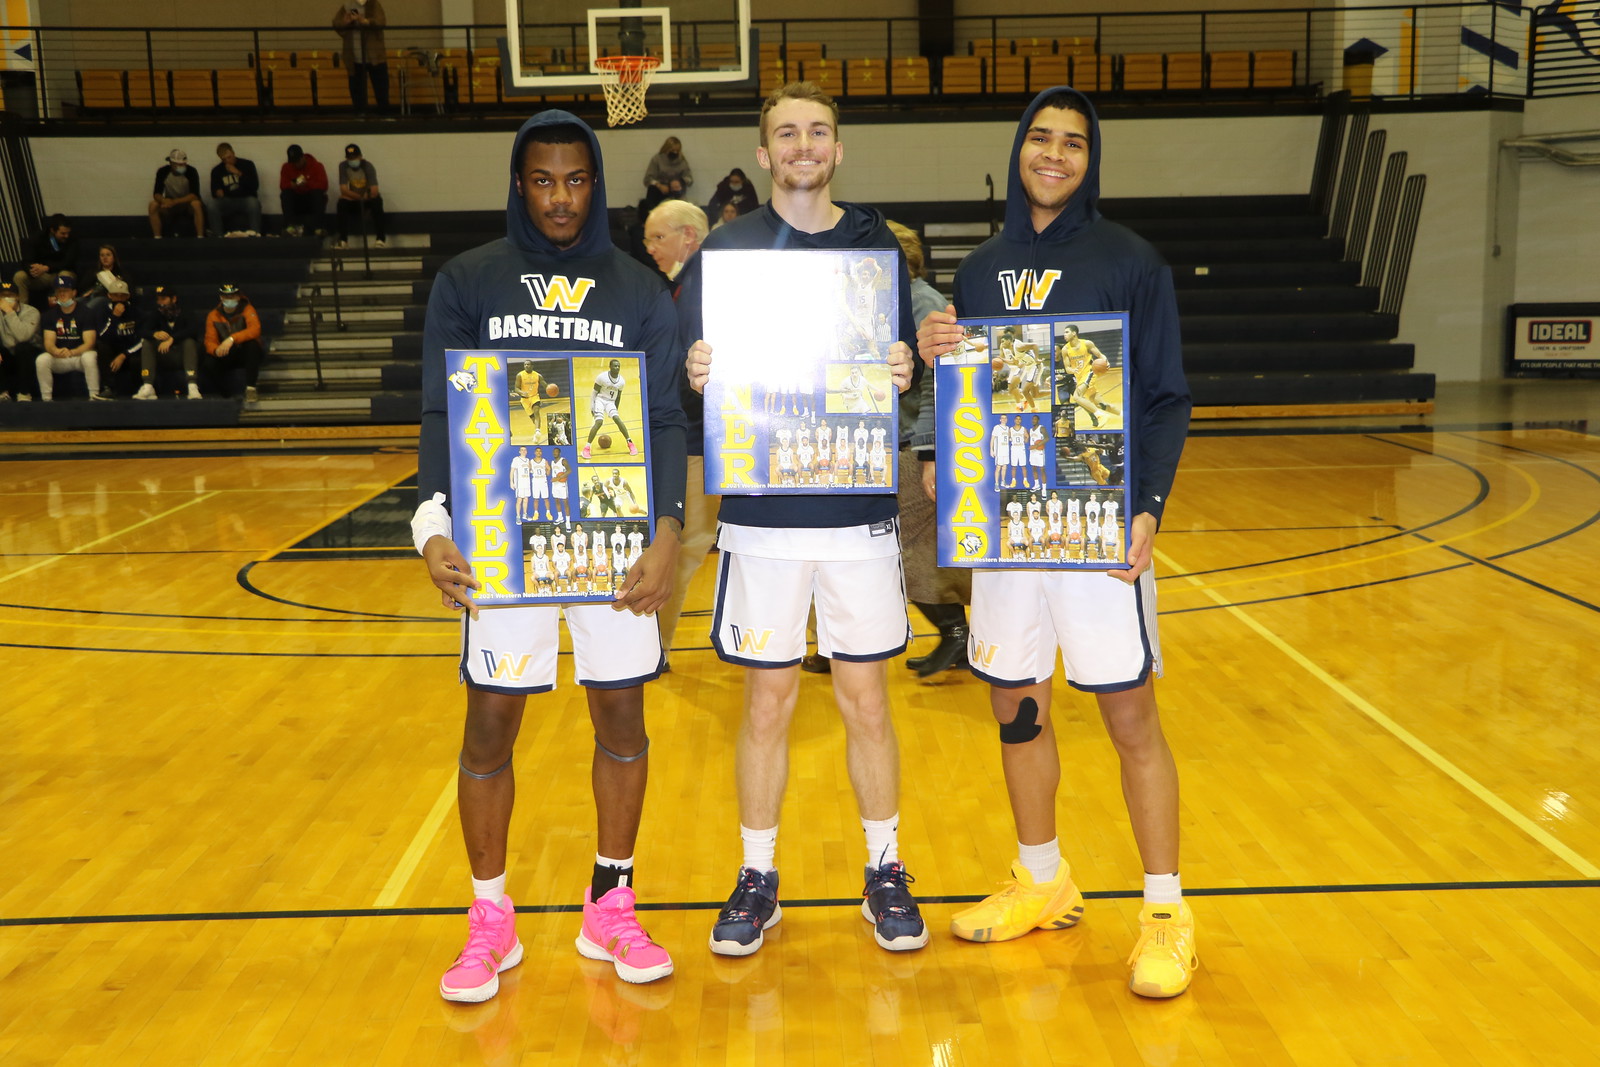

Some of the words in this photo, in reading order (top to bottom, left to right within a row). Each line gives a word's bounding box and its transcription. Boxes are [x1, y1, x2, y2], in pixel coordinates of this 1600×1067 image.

[489, 314, 623, 348] BASKETBALL
[1532, 324, 1587, 340] IDEAL
[463, 355, 513, 599] TAYLER
[1027, 557, 1061, 565] Community
[1062, 557, 1085, 565] College
[523, 591, 552, 599] Nebraska
[554, 590, 588, 599] Community
[588, 590, 613, 598] College
